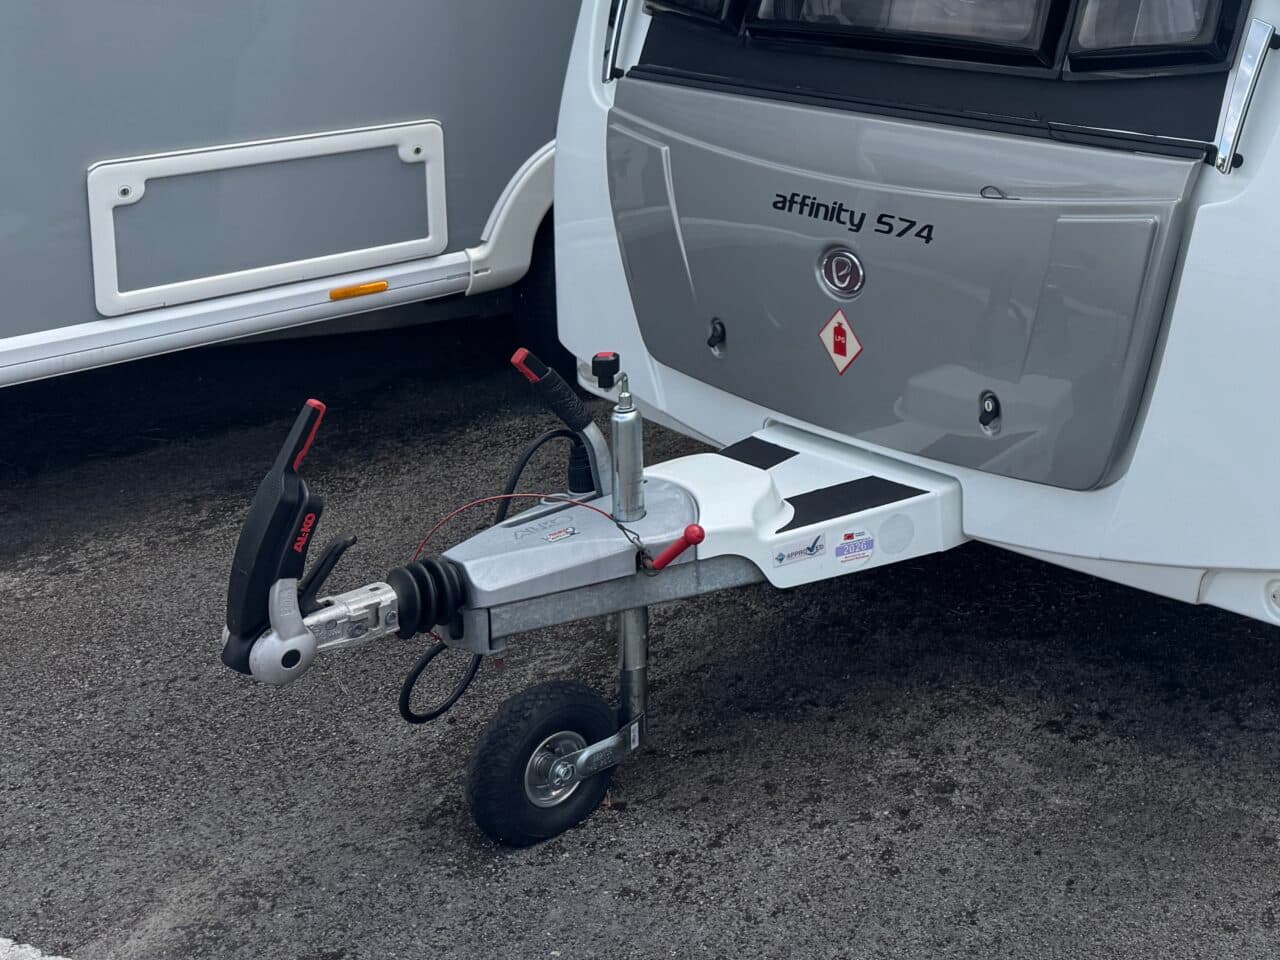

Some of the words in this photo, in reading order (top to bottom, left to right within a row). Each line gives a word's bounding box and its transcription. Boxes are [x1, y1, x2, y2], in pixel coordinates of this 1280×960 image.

[772, 192, 867, 233] affinity
[874, 213, 934, 244] 574
[843, 540, 867, 554] 2026
